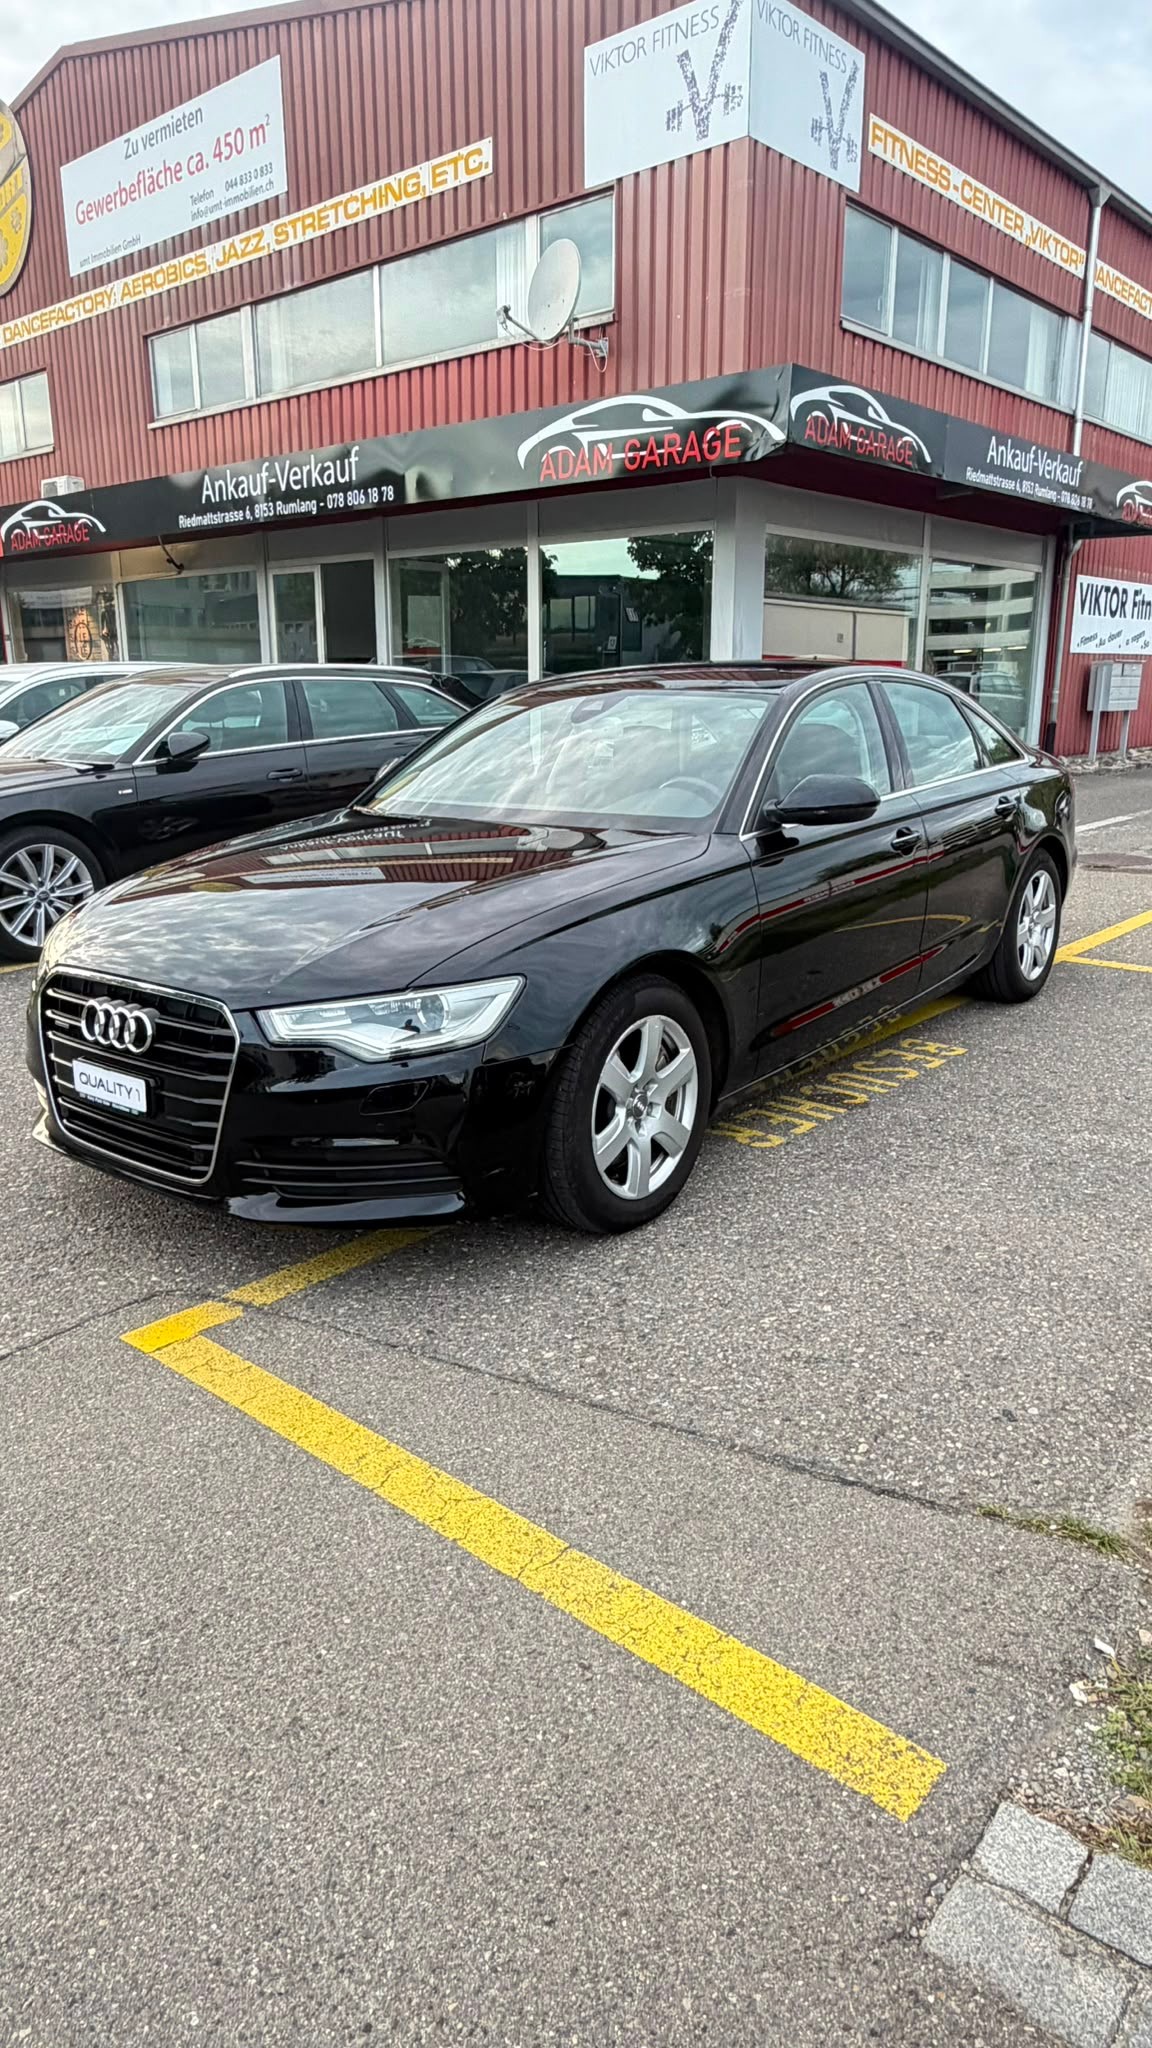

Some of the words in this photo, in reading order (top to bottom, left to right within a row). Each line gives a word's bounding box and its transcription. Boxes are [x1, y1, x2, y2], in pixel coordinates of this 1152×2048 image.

[590, 37, 647, 77] VIKTOR
[652, 6, 720, 52] FITNESS
[757, 0, 800, 44] VIKTOR
[803, 27, 847, 73] FITNESS
[124, 137, 140, 160] Zu
[142, 107, 204, 151] vermieten
[75, 160, 183, 225] Gewerbefläche
[187, 152, 209, 176] ca.
[213, 127, 244, 163] 450
[190, 189, 214, 206] Telefon
[225, 177, 238, 192] 044
[239, 170, 252, 186] 833
[253, 168, 259, 180] 0
[260, 161, 273, 178] 833
[91, 243, 122, 263] Immobilien
[122, 234, 141, 251] GmbH
[120, 251, 211, 304] AEROBICS,
[216, 229, 271, 267] JAZZ,
[274, 171, 427, 245] STRETCHING,
[431, 147, 489, 187] ETC.
[1094, 265, 1152, 315] ANCEFACT
[540, 442, 614, 482] ADAM
[623, 423, 742, 471] GARAGE
[804, 415, 852, 451] ADAM
[856, 426, 912, 467] GARAGE
[987, 436, 1083, 488] Ankauf-Verkauf
[202, 446, 359, 504] Ankauf-Verkauf
[965, 466, 1015, 490] Riedmattstrasse
[178, 510, 244, 529] Riedmattstrasse
[245, 505, 253, 521] 6,
[254, 502, 274, 518] 8153
[276, 499, 317, 515] Rumlang
[326, 492, 344, 509] 078
[347, 489, 366, 506] 806
[367, 487, 379, 503] 18
[381, 484, 394, 502] 78
[11, 527, 41, 551] ADAM
[44, 519, 90, 547] GARAGE
[1080, 582, 1127, 618] VIKTOR
[79, 1072, 133, 1099] QUALITY
[705, 1039, 968, 1148] BESUCHER
